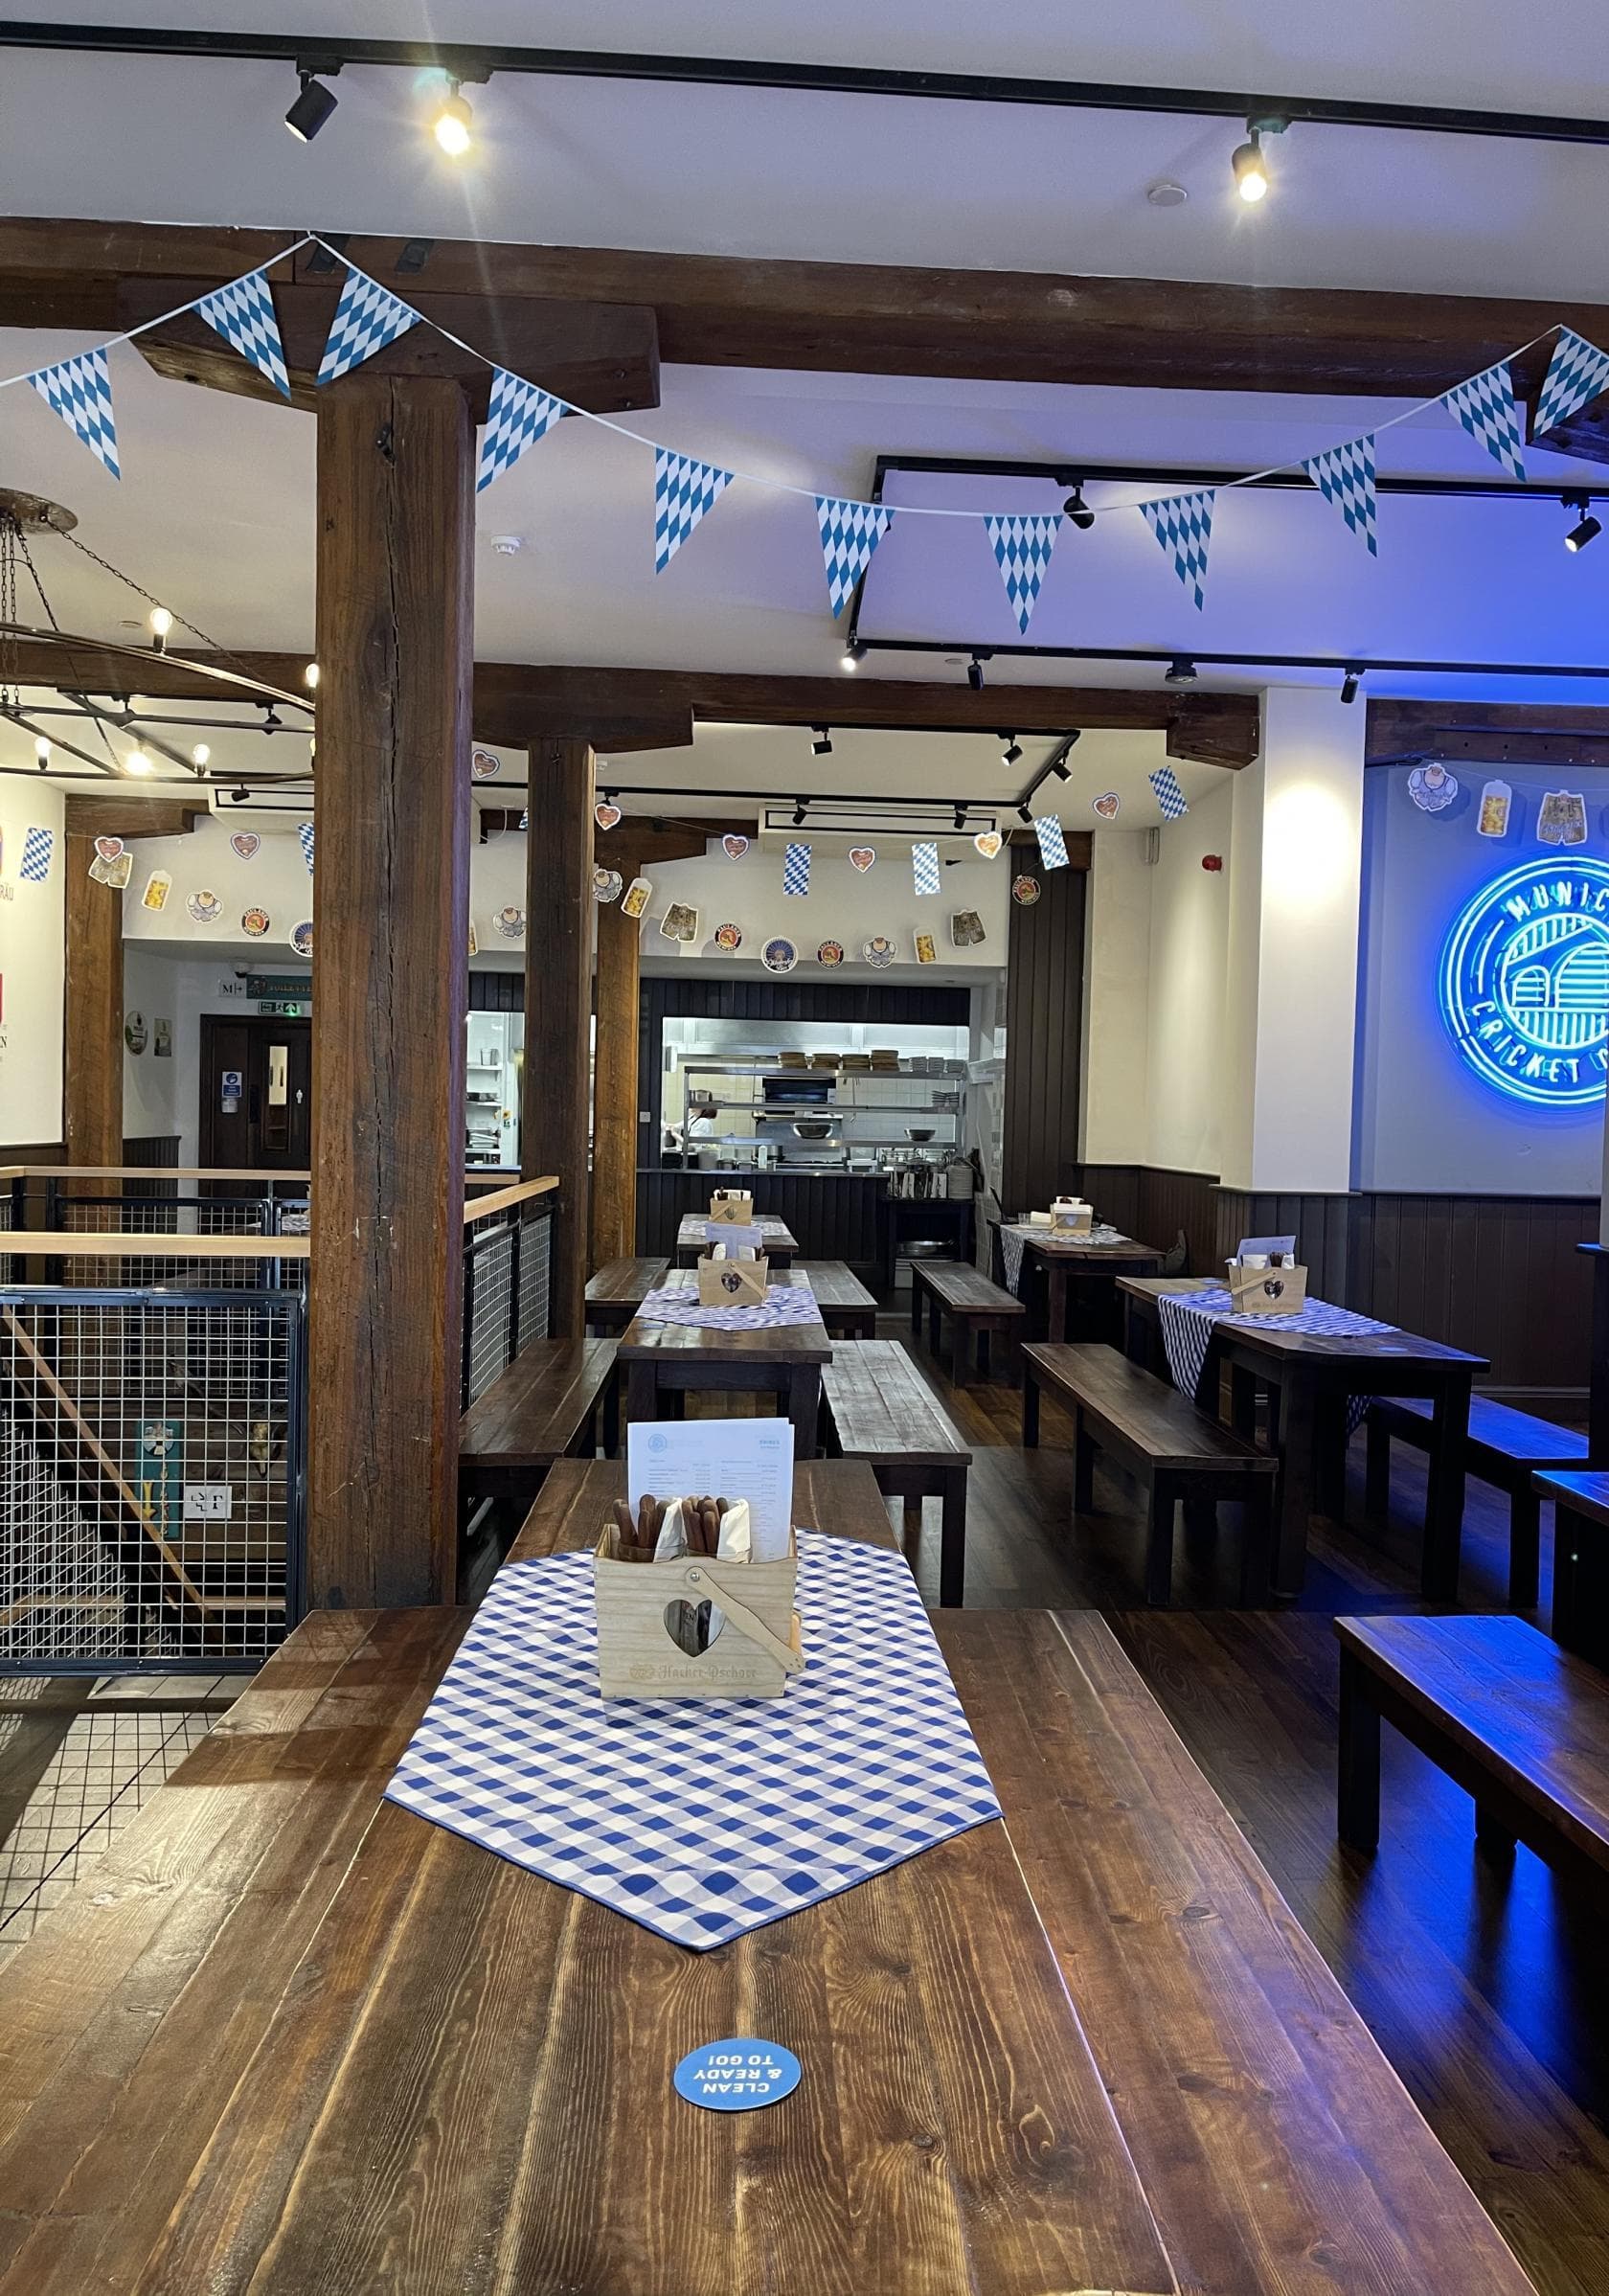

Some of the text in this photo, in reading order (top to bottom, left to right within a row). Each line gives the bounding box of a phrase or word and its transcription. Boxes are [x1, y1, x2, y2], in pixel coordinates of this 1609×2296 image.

[222, 984, 233, 993] M
[1471, 1000, 1580, 1084] CRICKET
[708, 2055, 775, 2066] TO GO!
[692, 2068, 782, 2080] & READY
[702, 2082, 770, 2094] CLEAN
